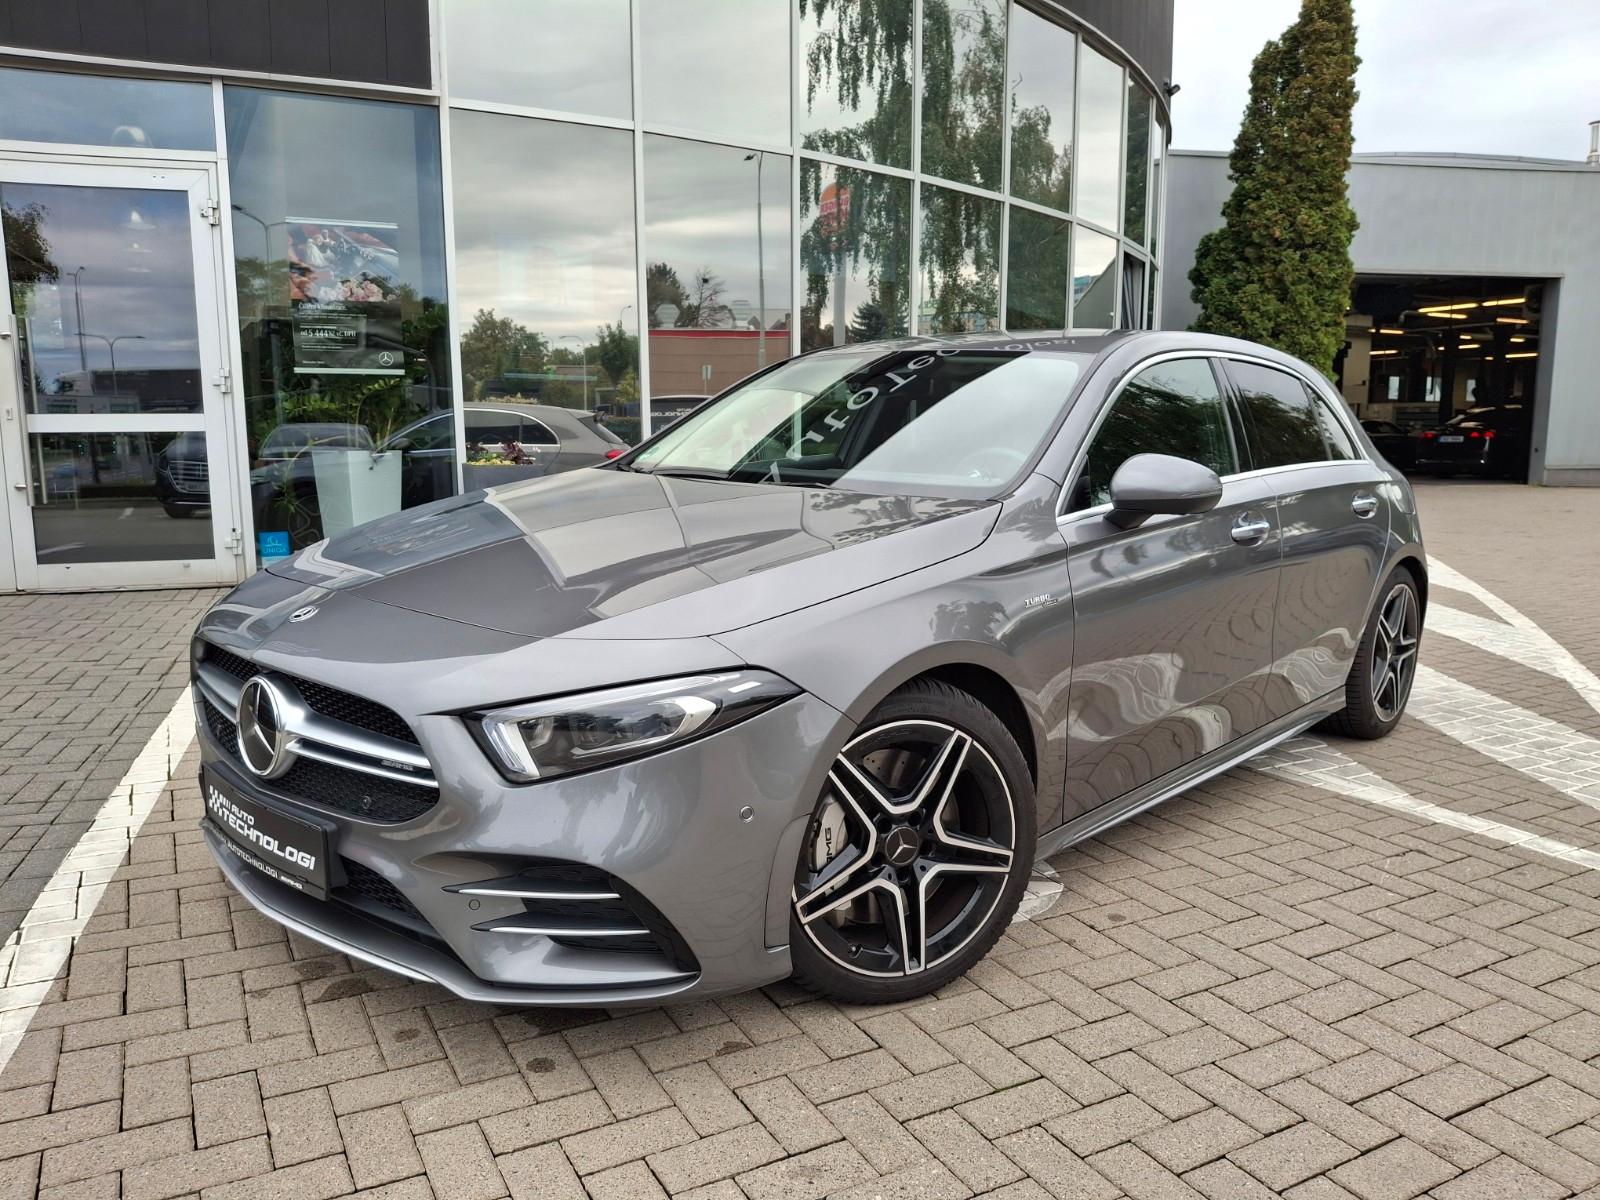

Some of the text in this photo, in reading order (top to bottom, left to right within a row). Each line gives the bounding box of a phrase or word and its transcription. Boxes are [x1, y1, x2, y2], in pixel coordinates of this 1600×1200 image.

[314, 329, 329, 337] 444
[231, 804, 255, 825] AUTO
[222, 808, 316, 870] TECHNOLOGI
